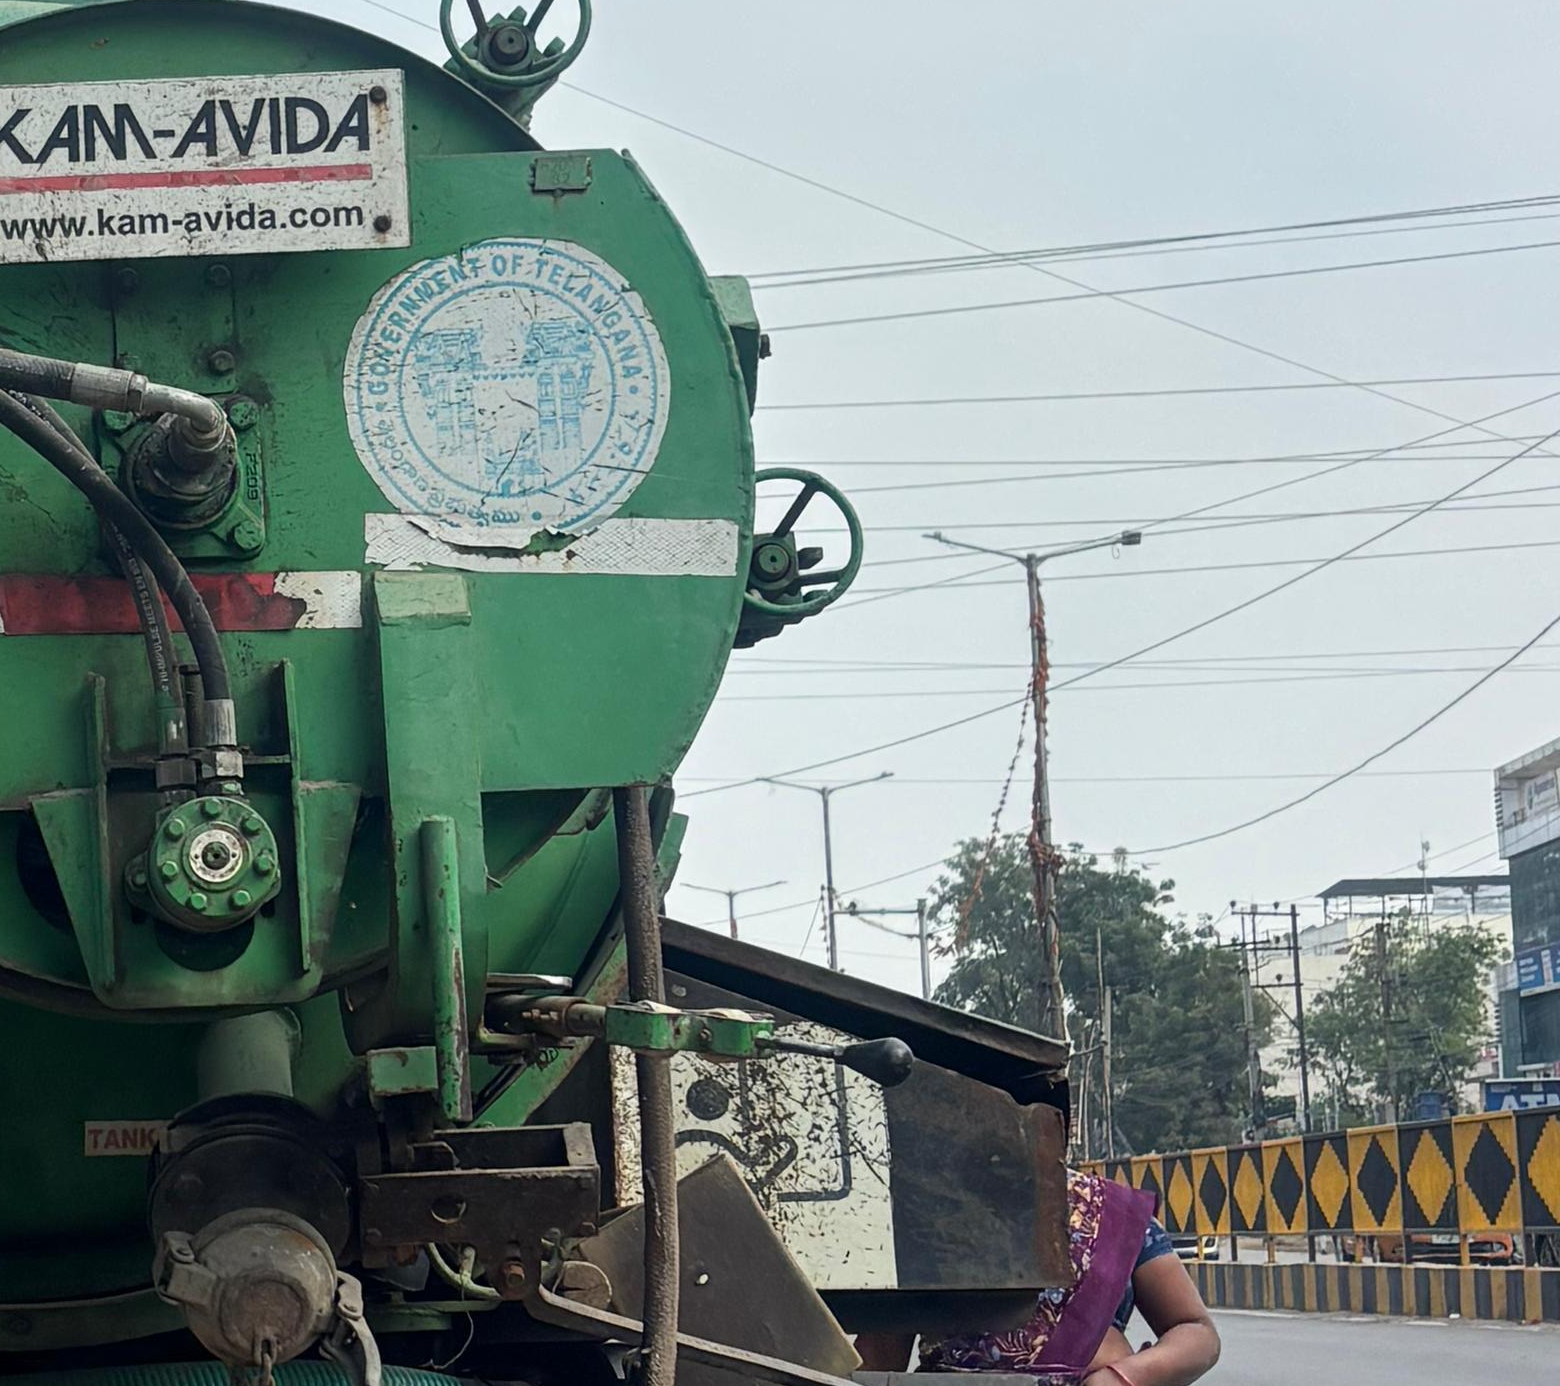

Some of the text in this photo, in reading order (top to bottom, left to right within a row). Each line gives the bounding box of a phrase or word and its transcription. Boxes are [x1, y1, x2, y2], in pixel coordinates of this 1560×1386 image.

[1, 202, 364, 240] www.kam-avida.com
[366, 253, 643, 396] GOVERNMENT OF TELANGANA
